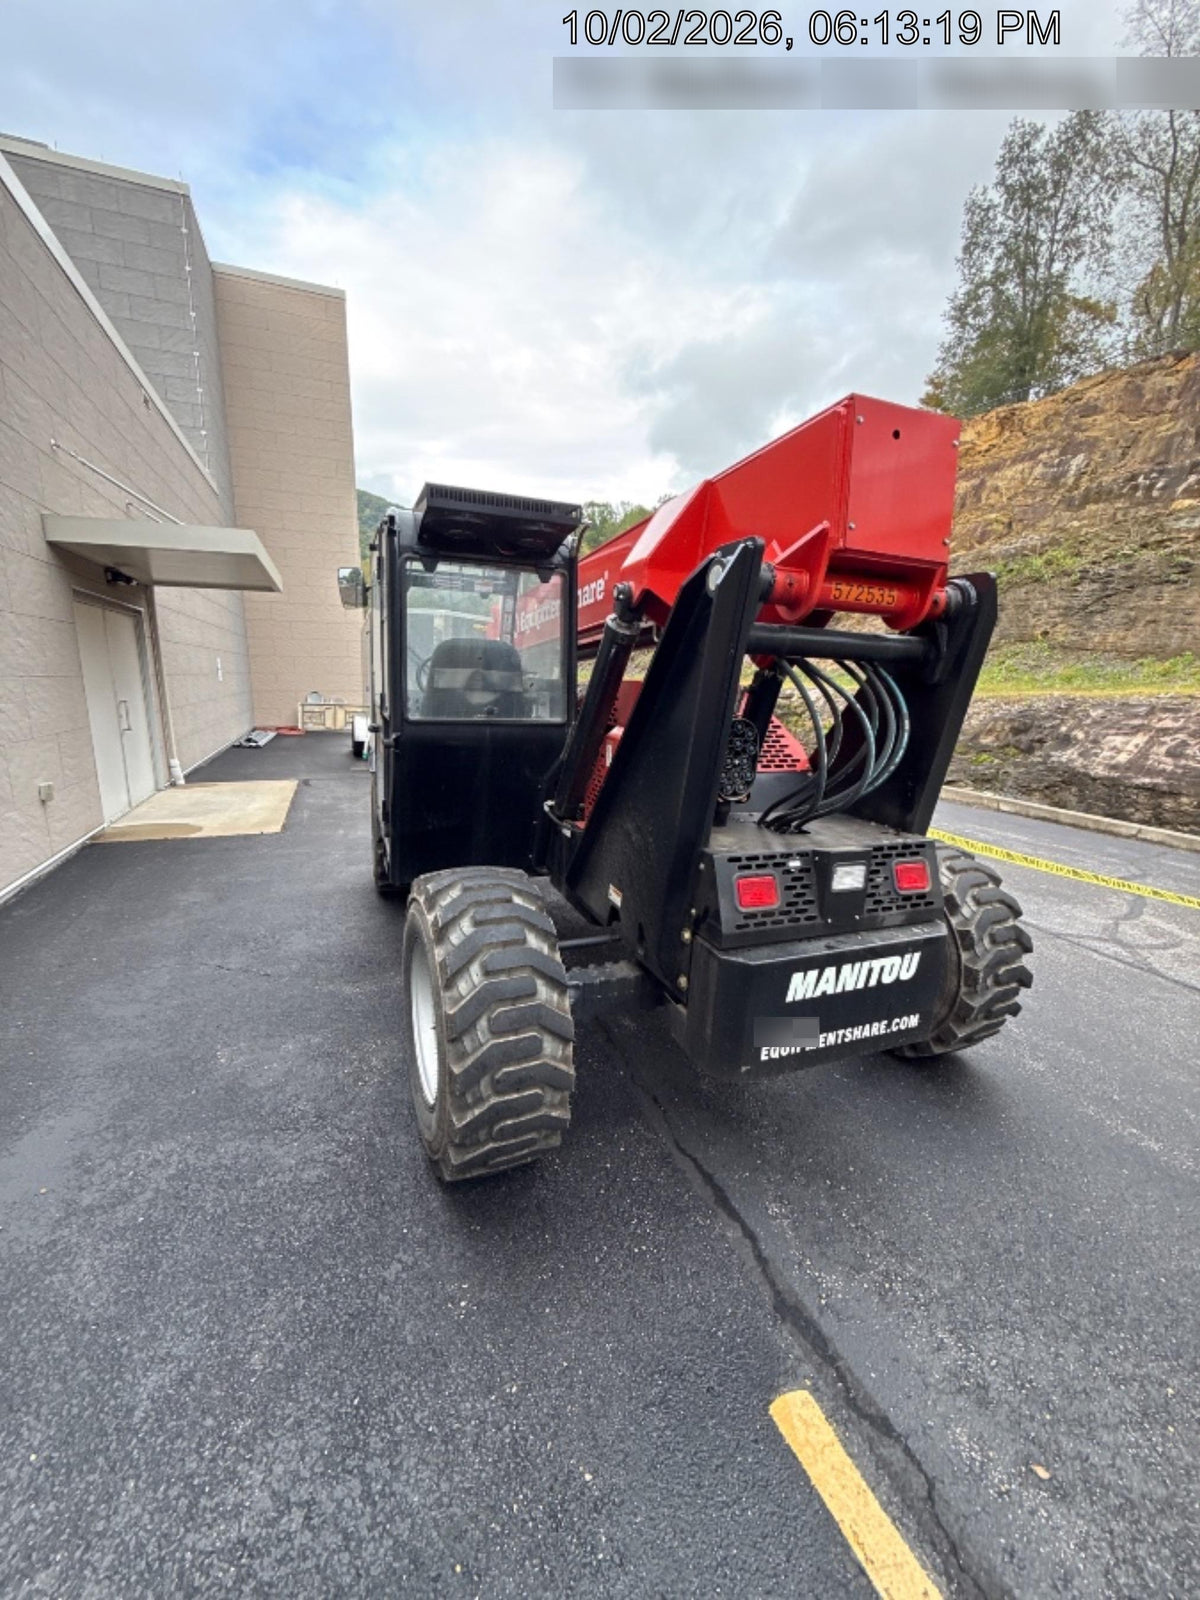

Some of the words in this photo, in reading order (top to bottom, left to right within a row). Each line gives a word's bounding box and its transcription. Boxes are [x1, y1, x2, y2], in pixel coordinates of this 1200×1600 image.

[832, 581, 896, 606] 572535
[785, 951, 922, 1004] MANITOU
[760, 1013, 921, 1062] EQUIENTSHARE.COM
